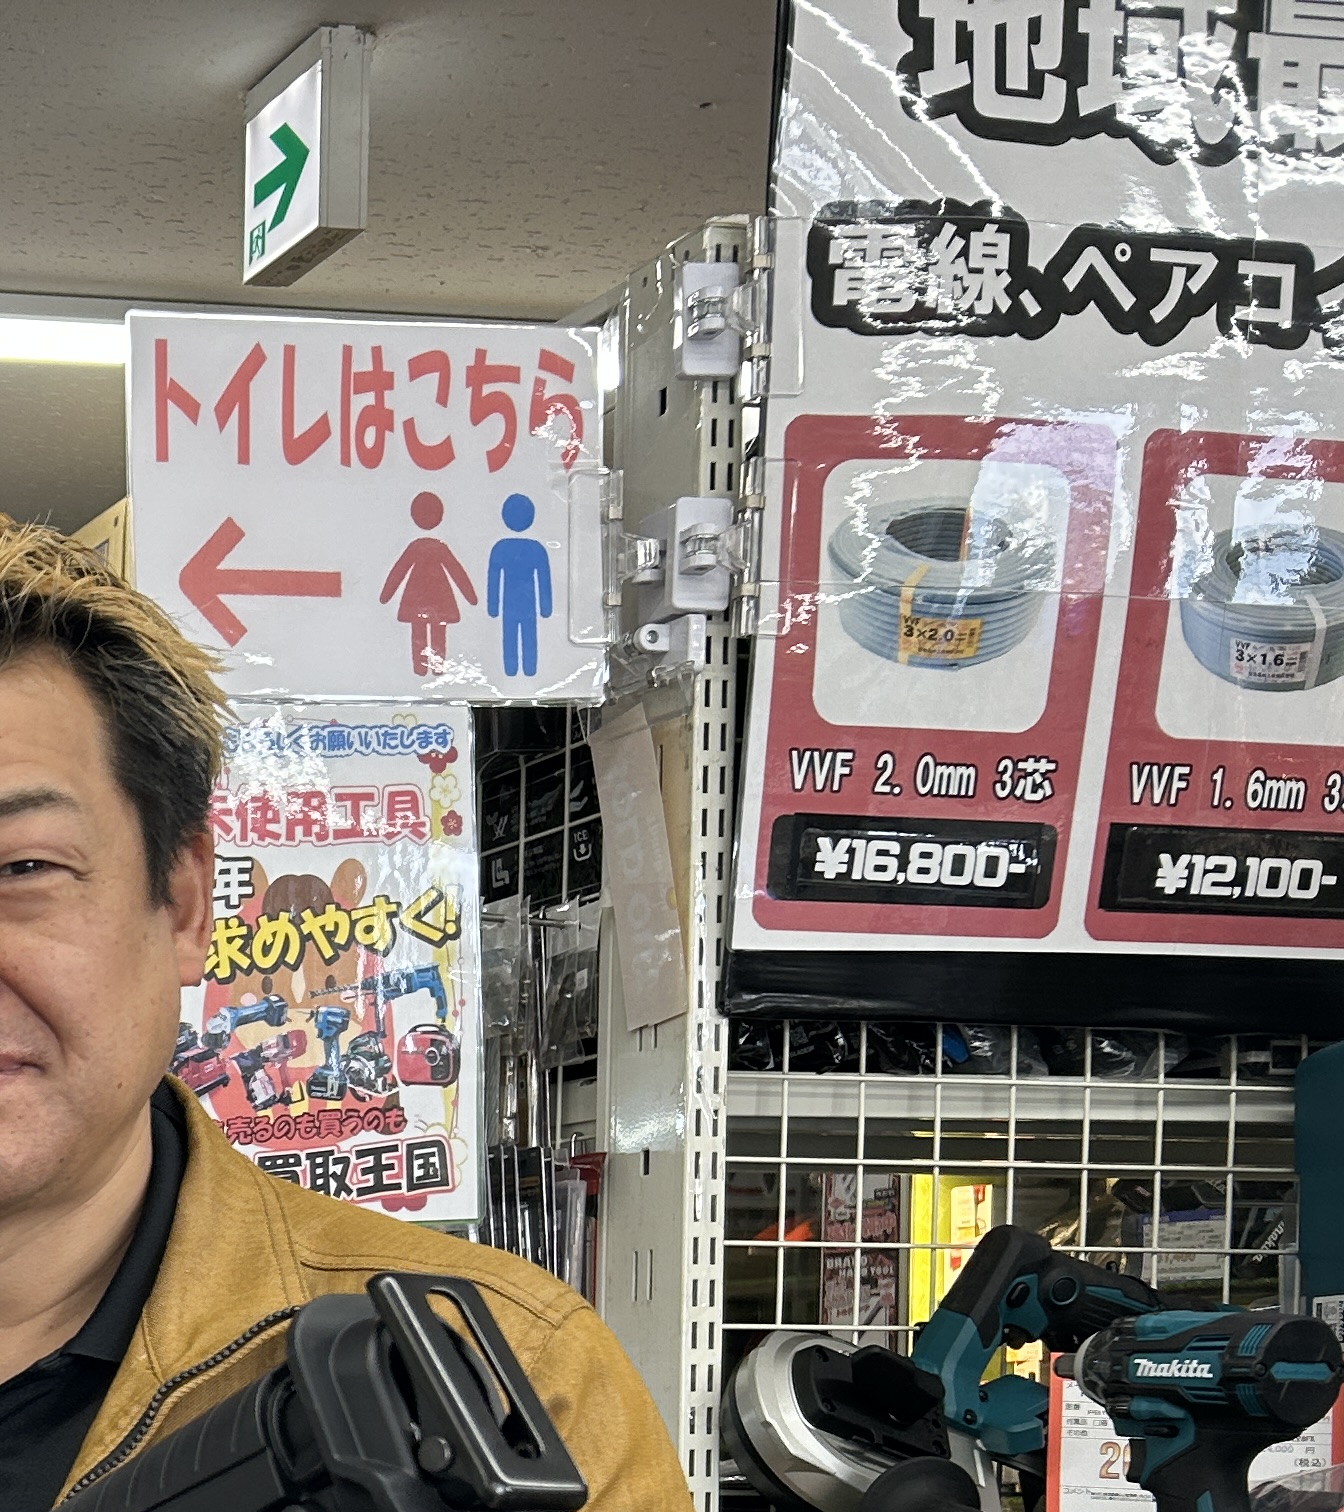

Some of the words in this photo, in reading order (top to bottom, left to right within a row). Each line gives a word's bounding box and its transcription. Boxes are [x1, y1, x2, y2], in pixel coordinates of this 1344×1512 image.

[154, 337, 587, 474] トイレはこちら
[791, 750, 855, 792] VVF
[874, 753, 976, 798] 2.0mm
[995, 757, 1058, 801] 3芯
[1130, 764, 1191, 806] VVF
[1212, 769, 1308, 811] 1.6mm
